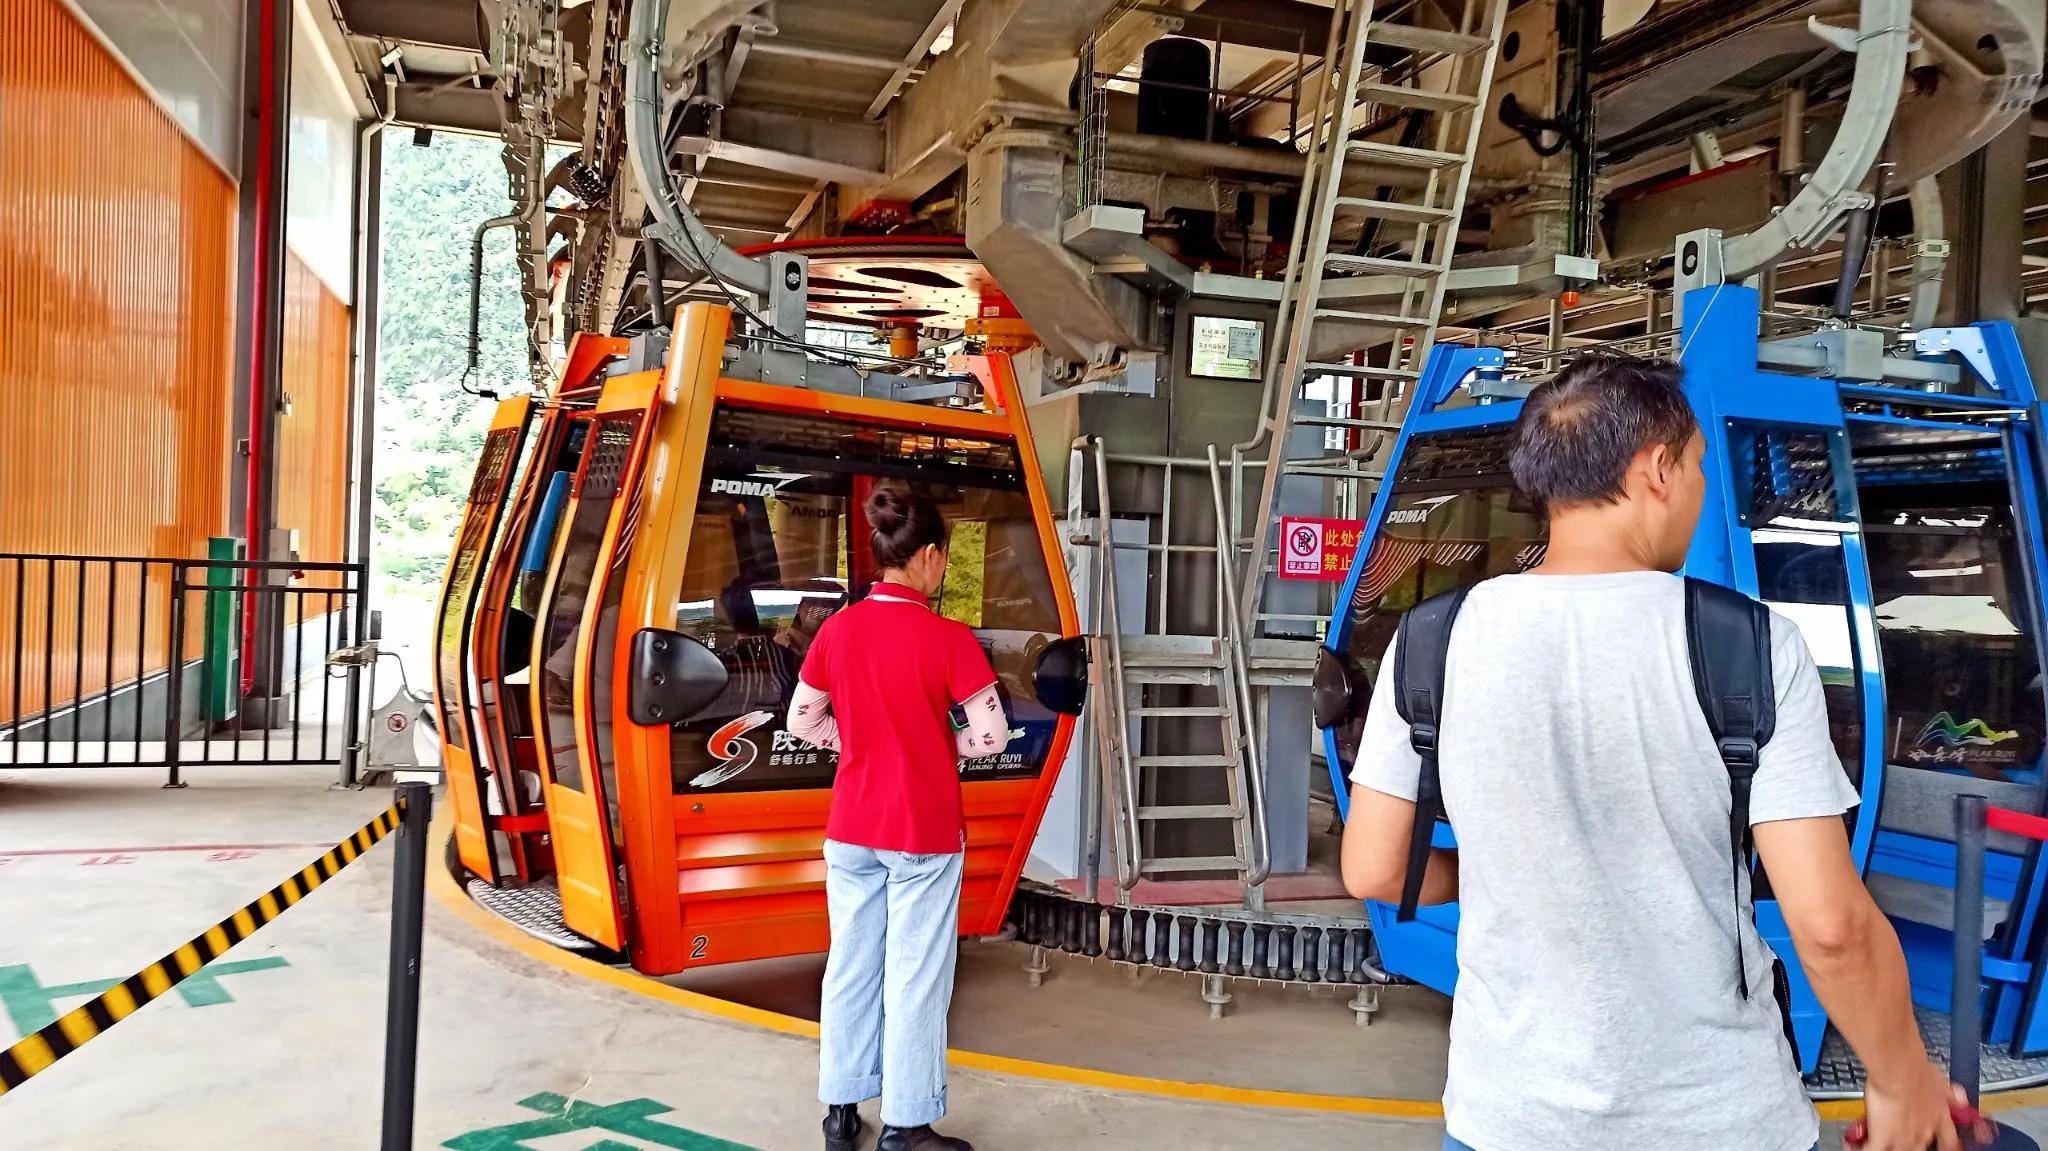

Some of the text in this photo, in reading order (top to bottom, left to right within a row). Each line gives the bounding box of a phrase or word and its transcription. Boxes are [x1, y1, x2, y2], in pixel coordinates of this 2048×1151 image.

[711, 479, 776, 497] POMA
[1386, 509, 1427, 523] POMA
[1324, 553, 1352, 571] 禁止
[769, 753, 818, 766] 舒畅行旅
[1000, 753, 1022, 763] RUYI
[690, 935, 709, 960] 2
